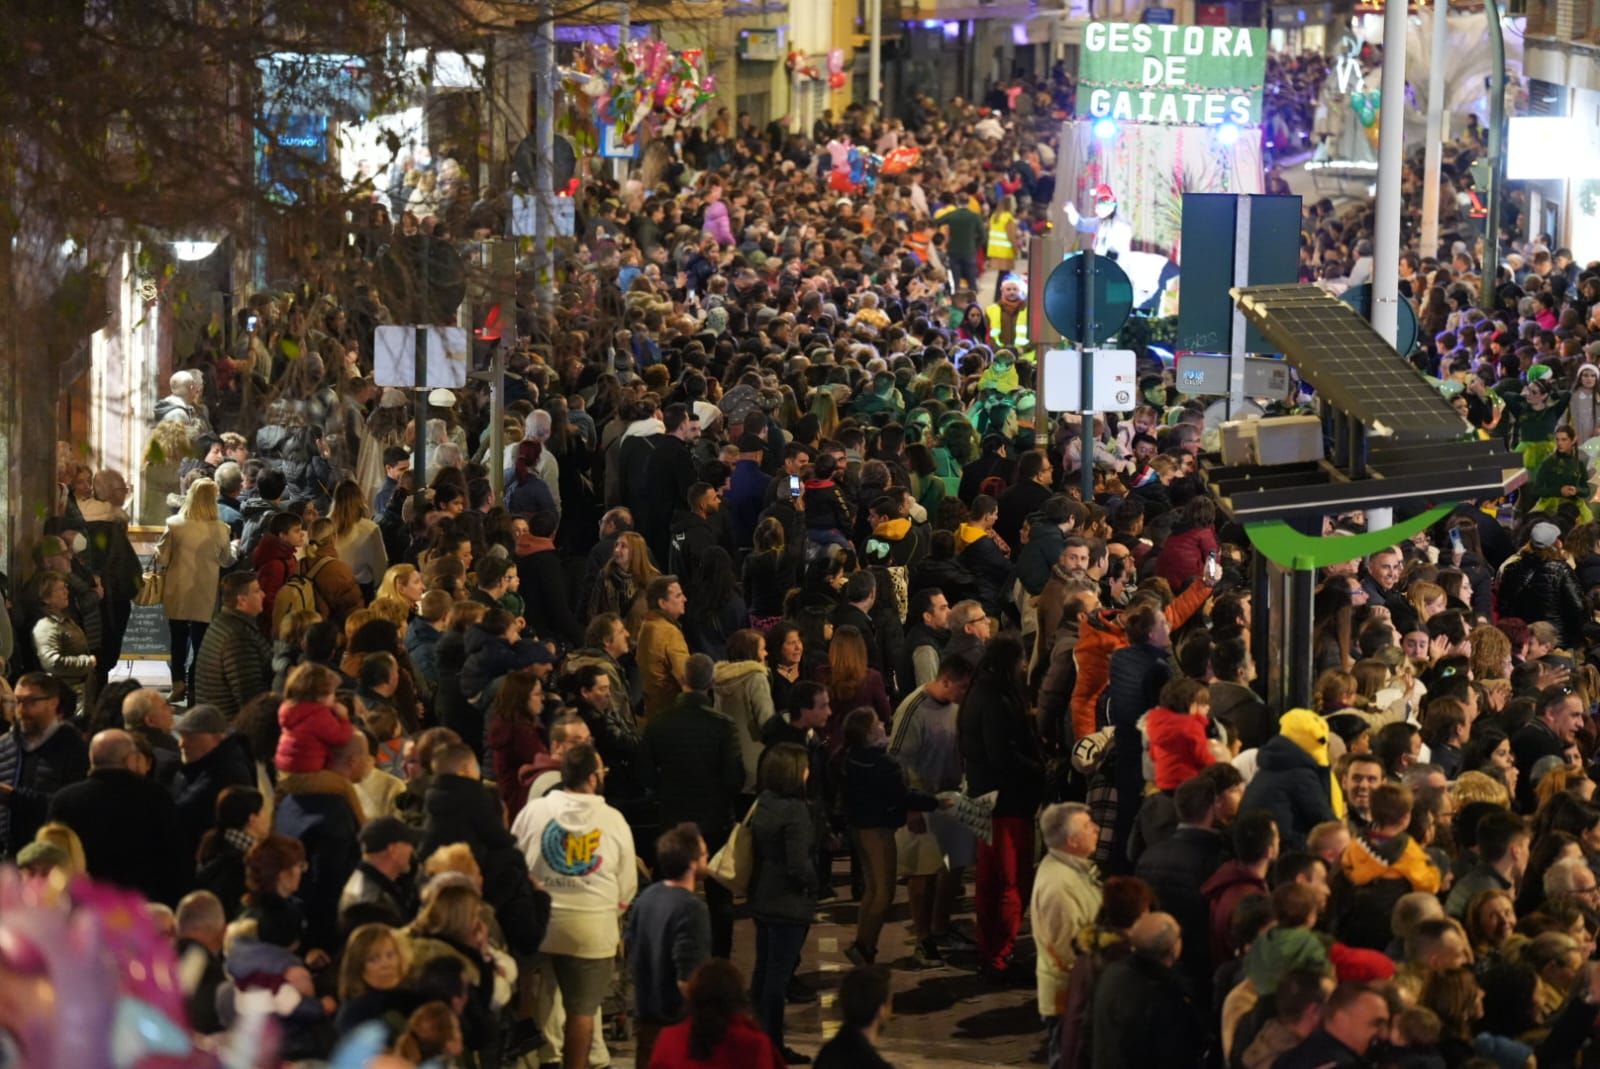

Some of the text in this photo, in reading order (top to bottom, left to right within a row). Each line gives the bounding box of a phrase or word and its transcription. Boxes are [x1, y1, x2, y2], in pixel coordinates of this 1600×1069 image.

[1085, 23, 1253, 57] GESTORA
[1142, 56, 1187, 87] DE
[1090, 90, 1251, 124] GAIATES
